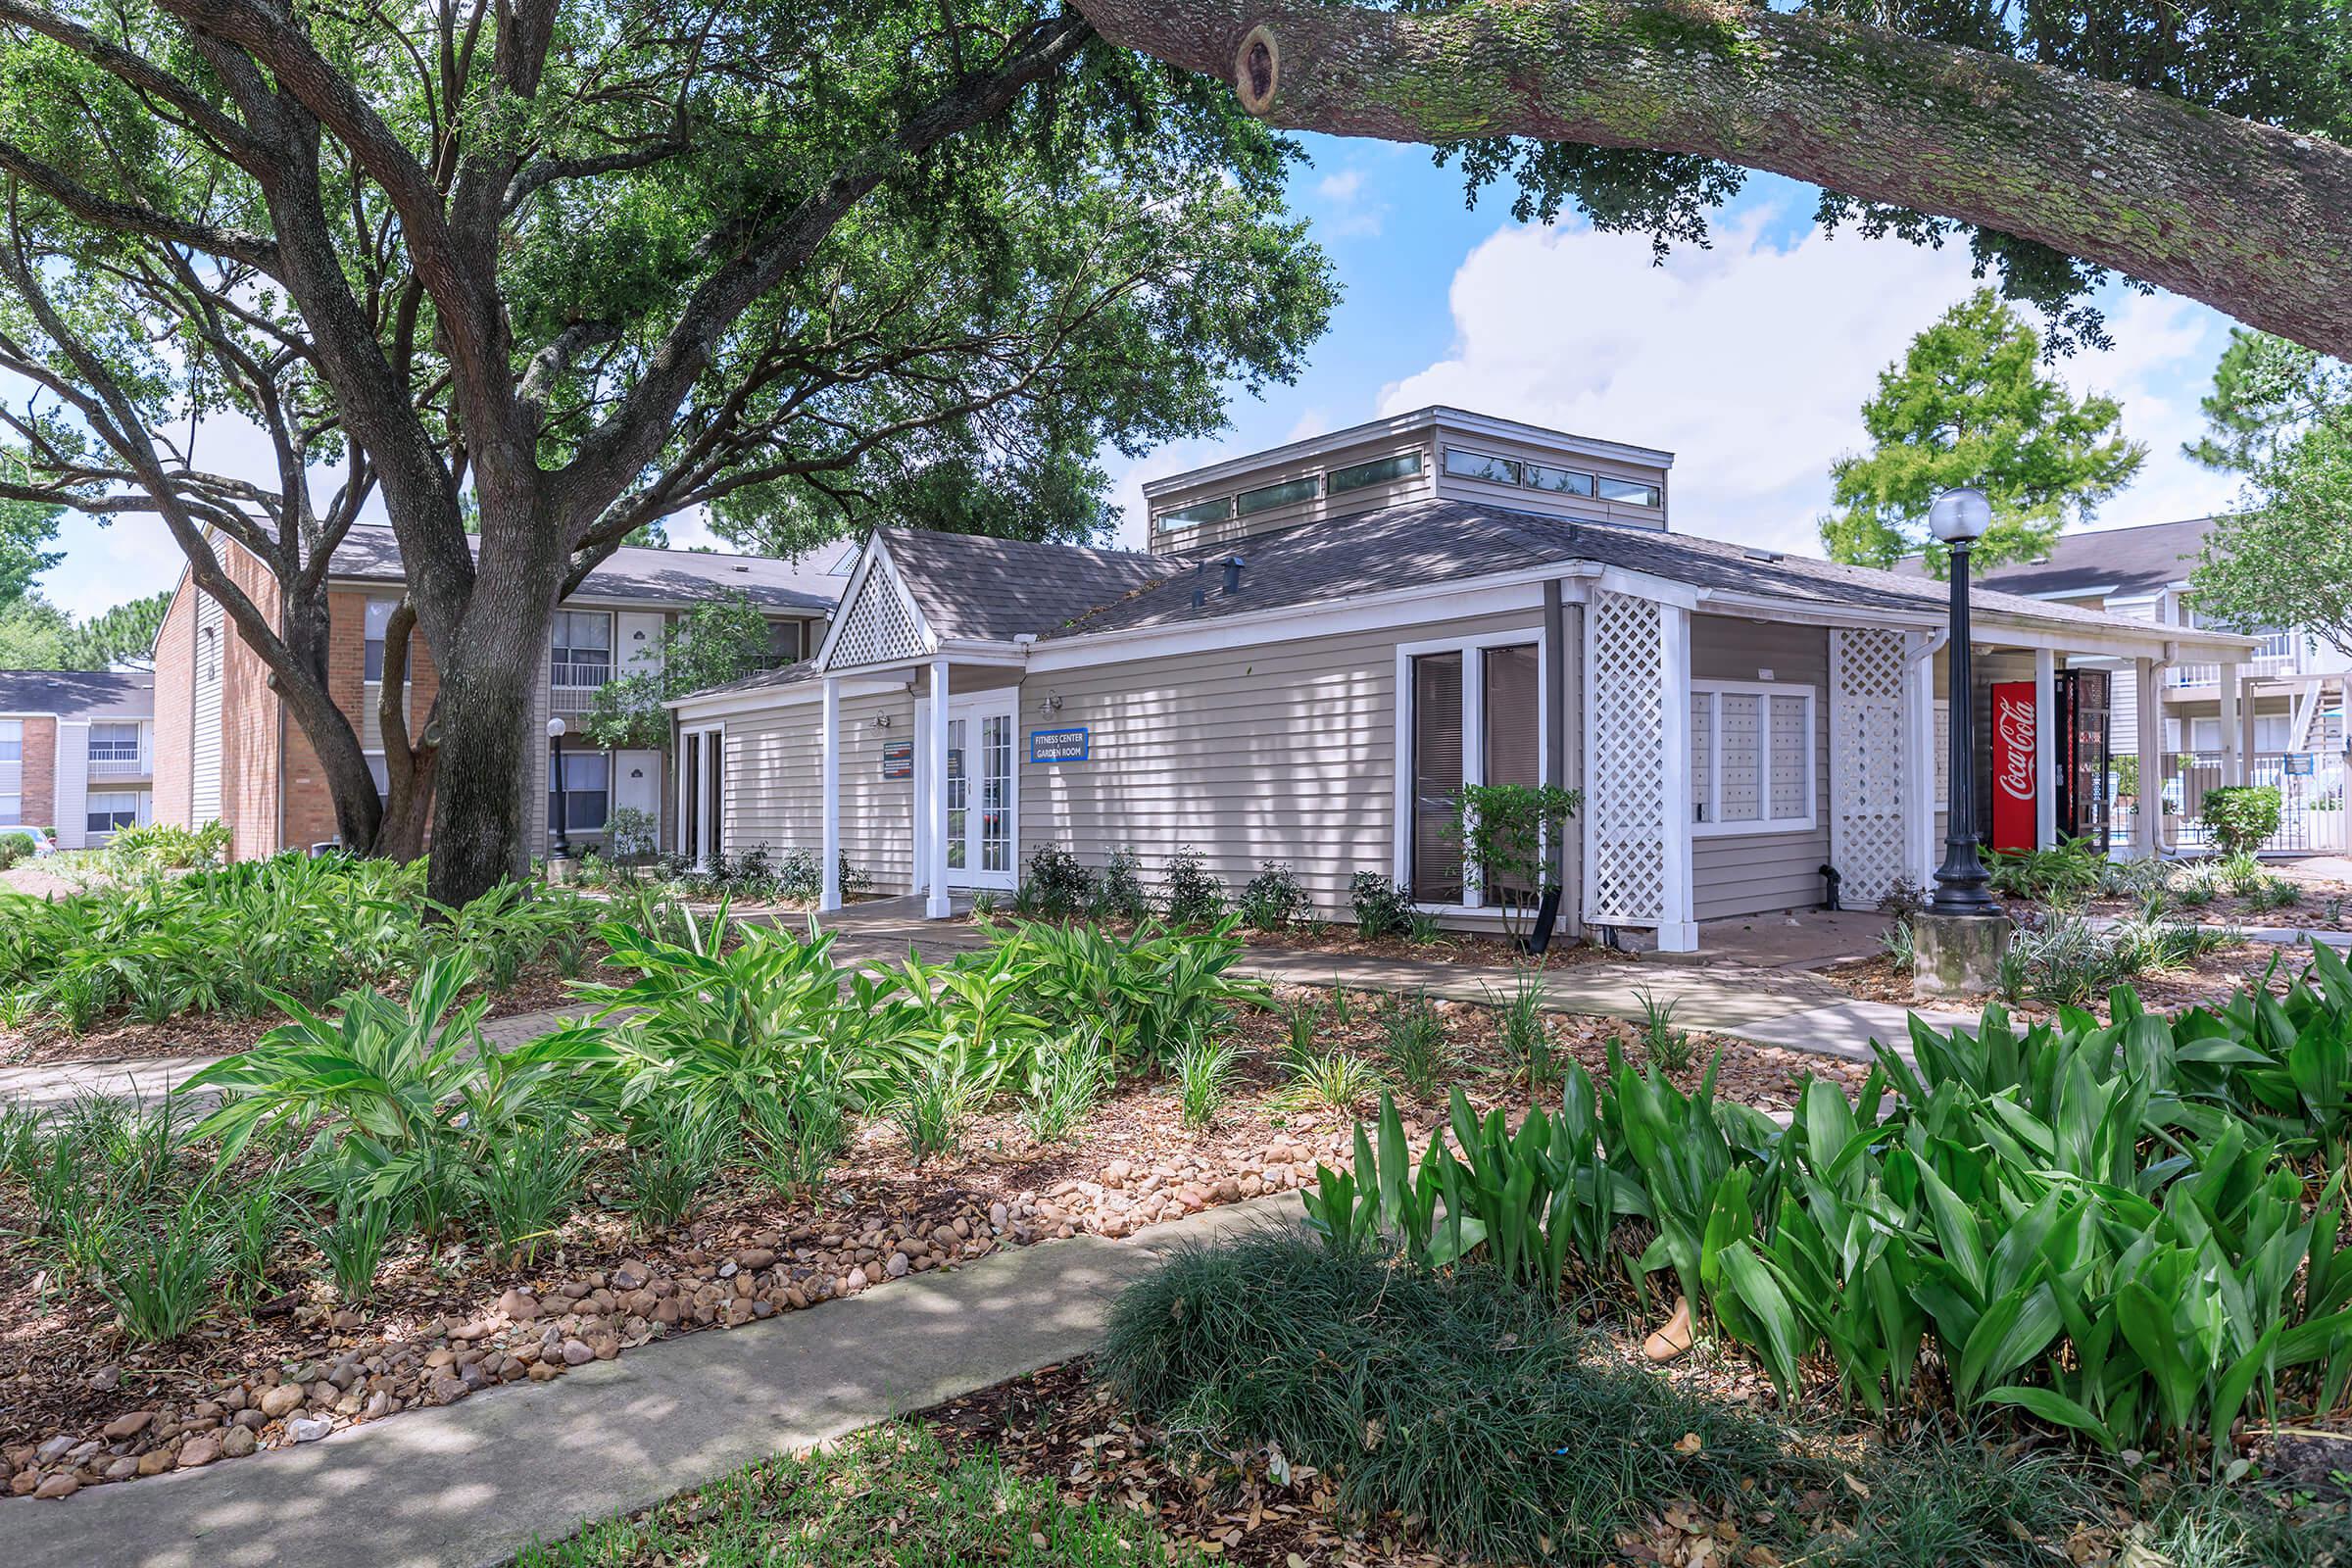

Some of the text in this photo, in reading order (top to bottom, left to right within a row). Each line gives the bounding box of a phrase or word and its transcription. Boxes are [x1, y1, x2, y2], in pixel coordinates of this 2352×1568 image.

[1035, 733, 1083, 745] FITNESS CENTER
[1037, 747, 1081, 759] GARDEN ROOM
